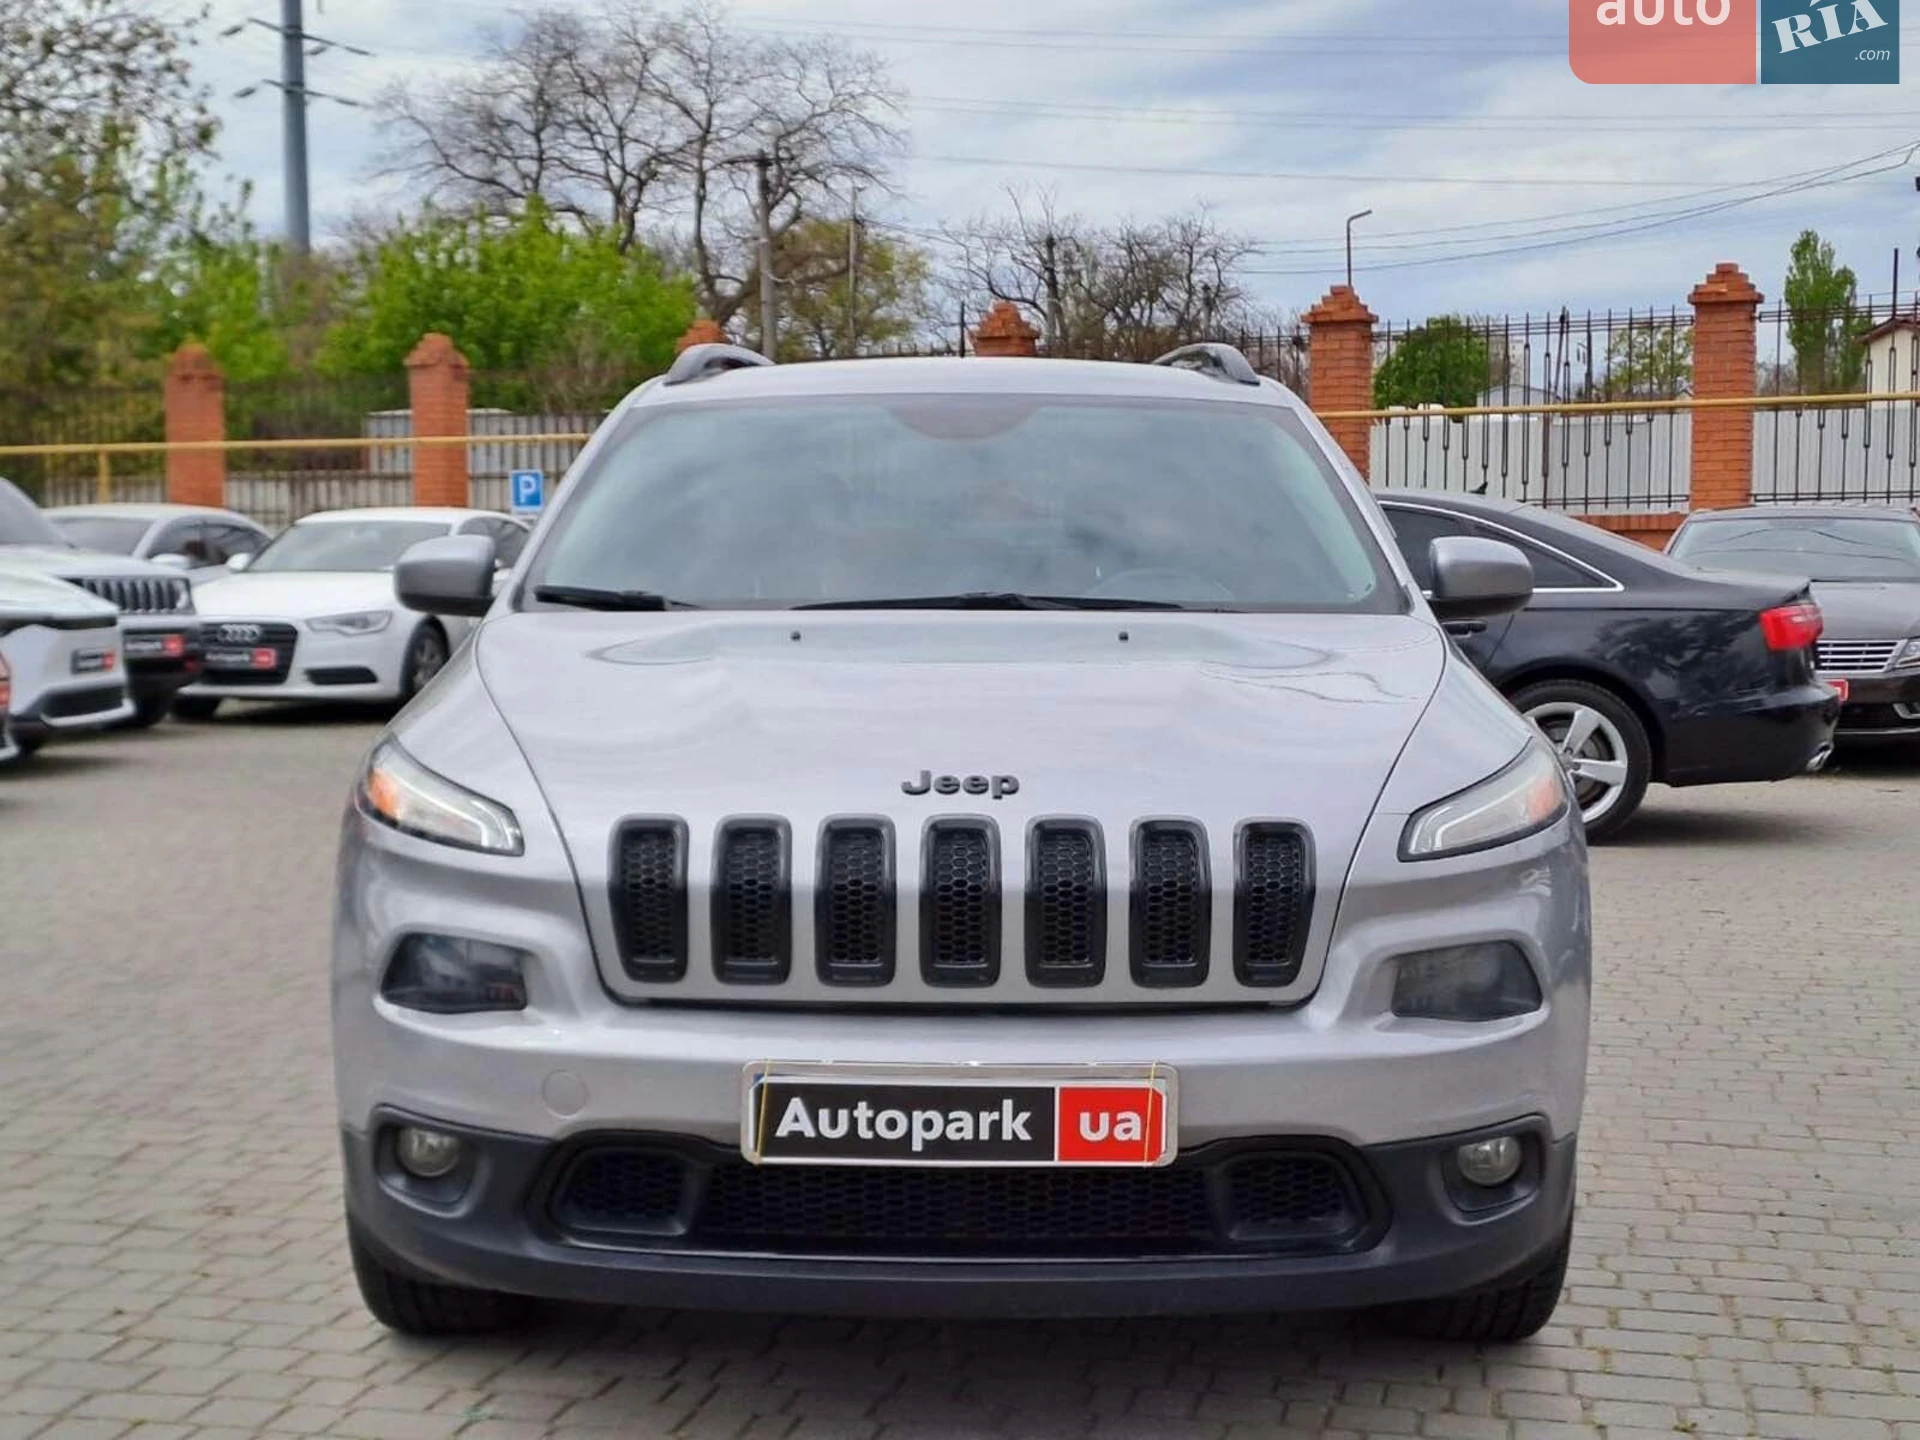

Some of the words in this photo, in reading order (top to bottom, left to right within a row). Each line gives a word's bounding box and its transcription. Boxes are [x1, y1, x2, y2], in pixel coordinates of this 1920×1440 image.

[519, 475, 536, 503] P
[900, 769, 1020, 800] Jeep
[775, 1097, 1032, 1151] Autopark
[1079, 1110, 1142, 1142] ua
